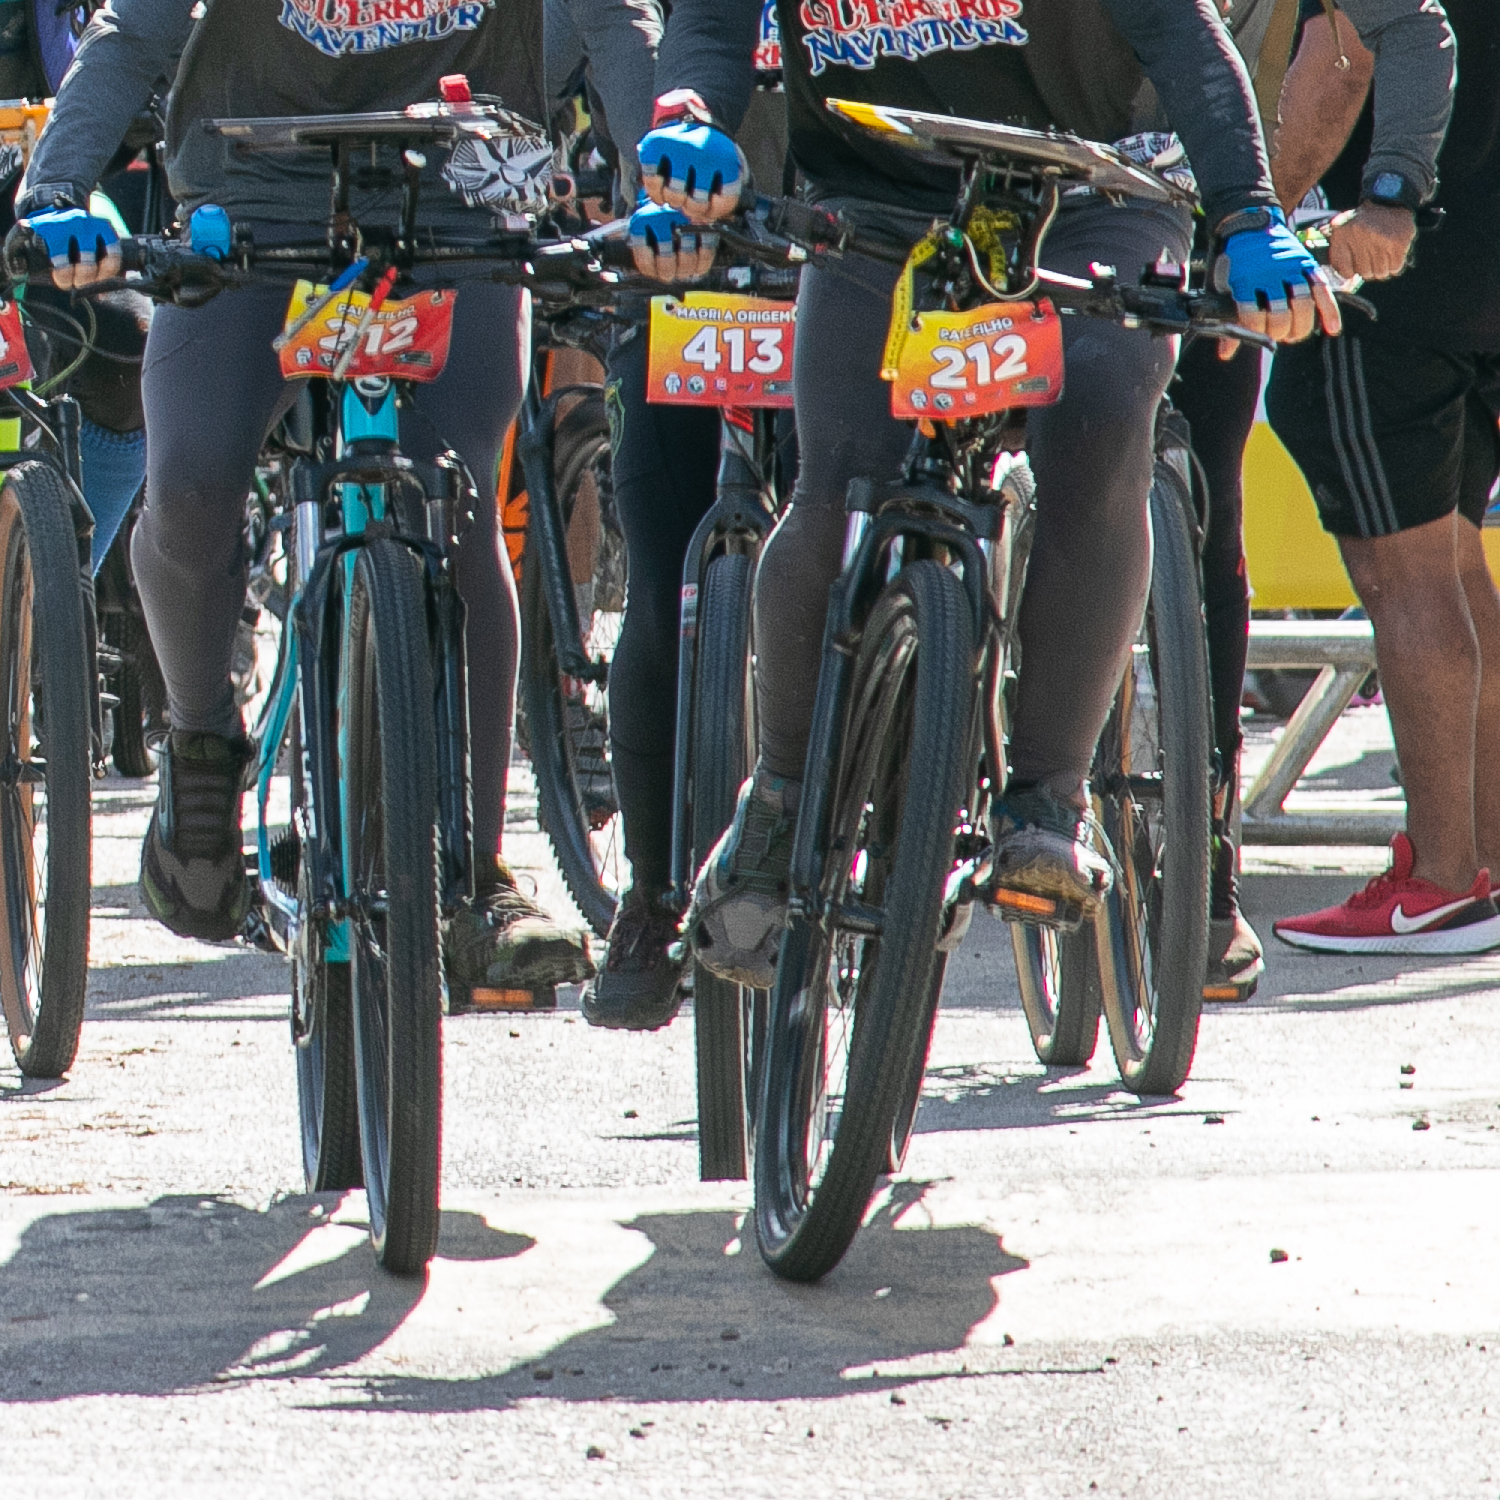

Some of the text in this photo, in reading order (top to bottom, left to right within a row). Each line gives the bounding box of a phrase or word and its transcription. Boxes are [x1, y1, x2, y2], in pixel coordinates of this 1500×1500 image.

[317, 316, 419, 356] 212
[737, 310, 791, 324] ORIGEM
[682, 325, 785, 375] 413
[930, 332, 1029, 390] 212
